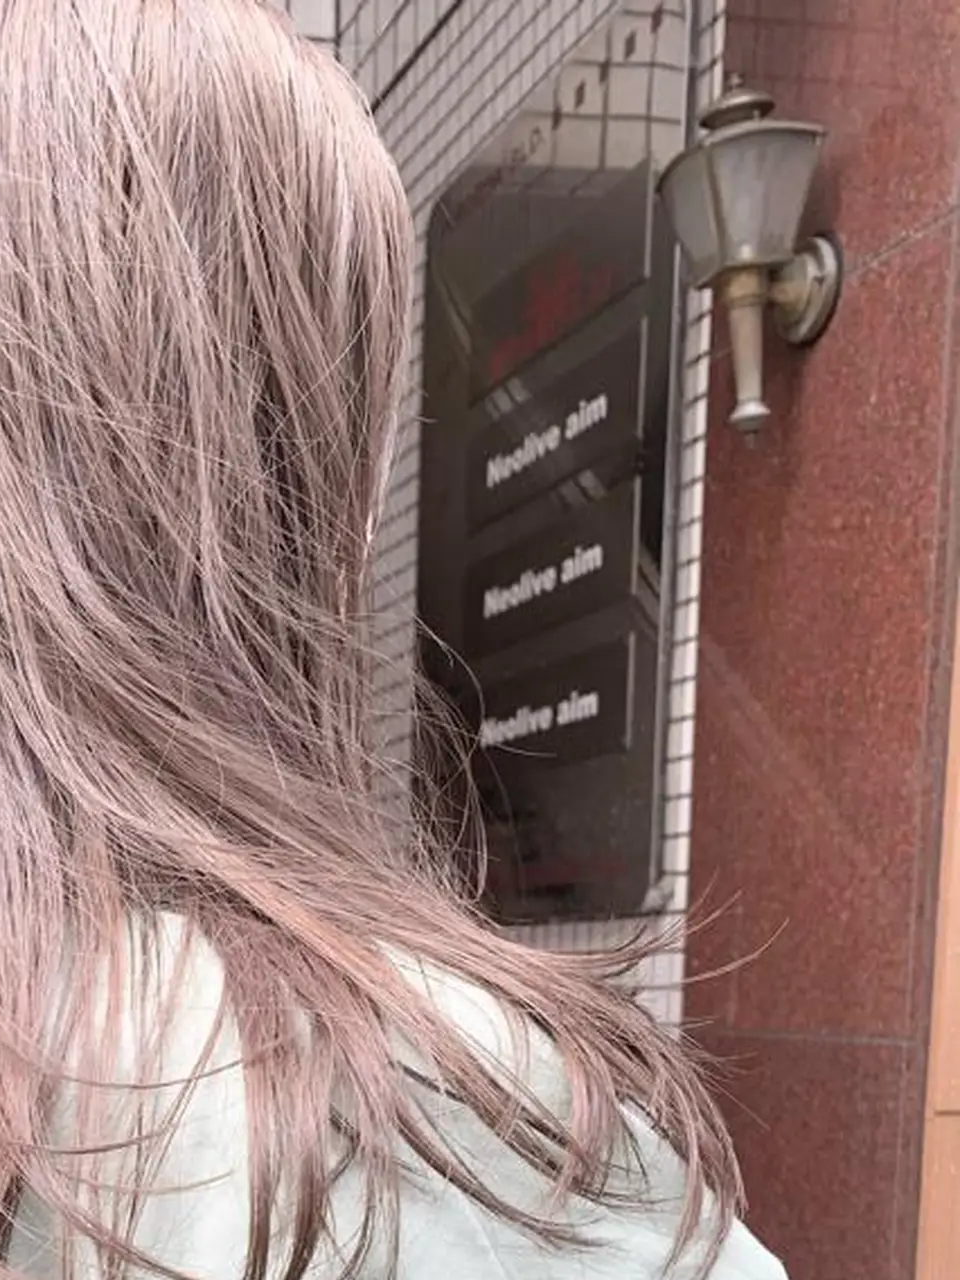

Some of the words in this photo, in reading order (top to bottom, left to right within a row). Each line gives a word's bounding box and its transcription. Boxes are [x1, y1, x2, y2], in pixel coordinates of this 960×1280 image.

[565, 394, 607, 439] aim
[561, 543, 603, 583] aim
[557, 690, 599, 725] aim
